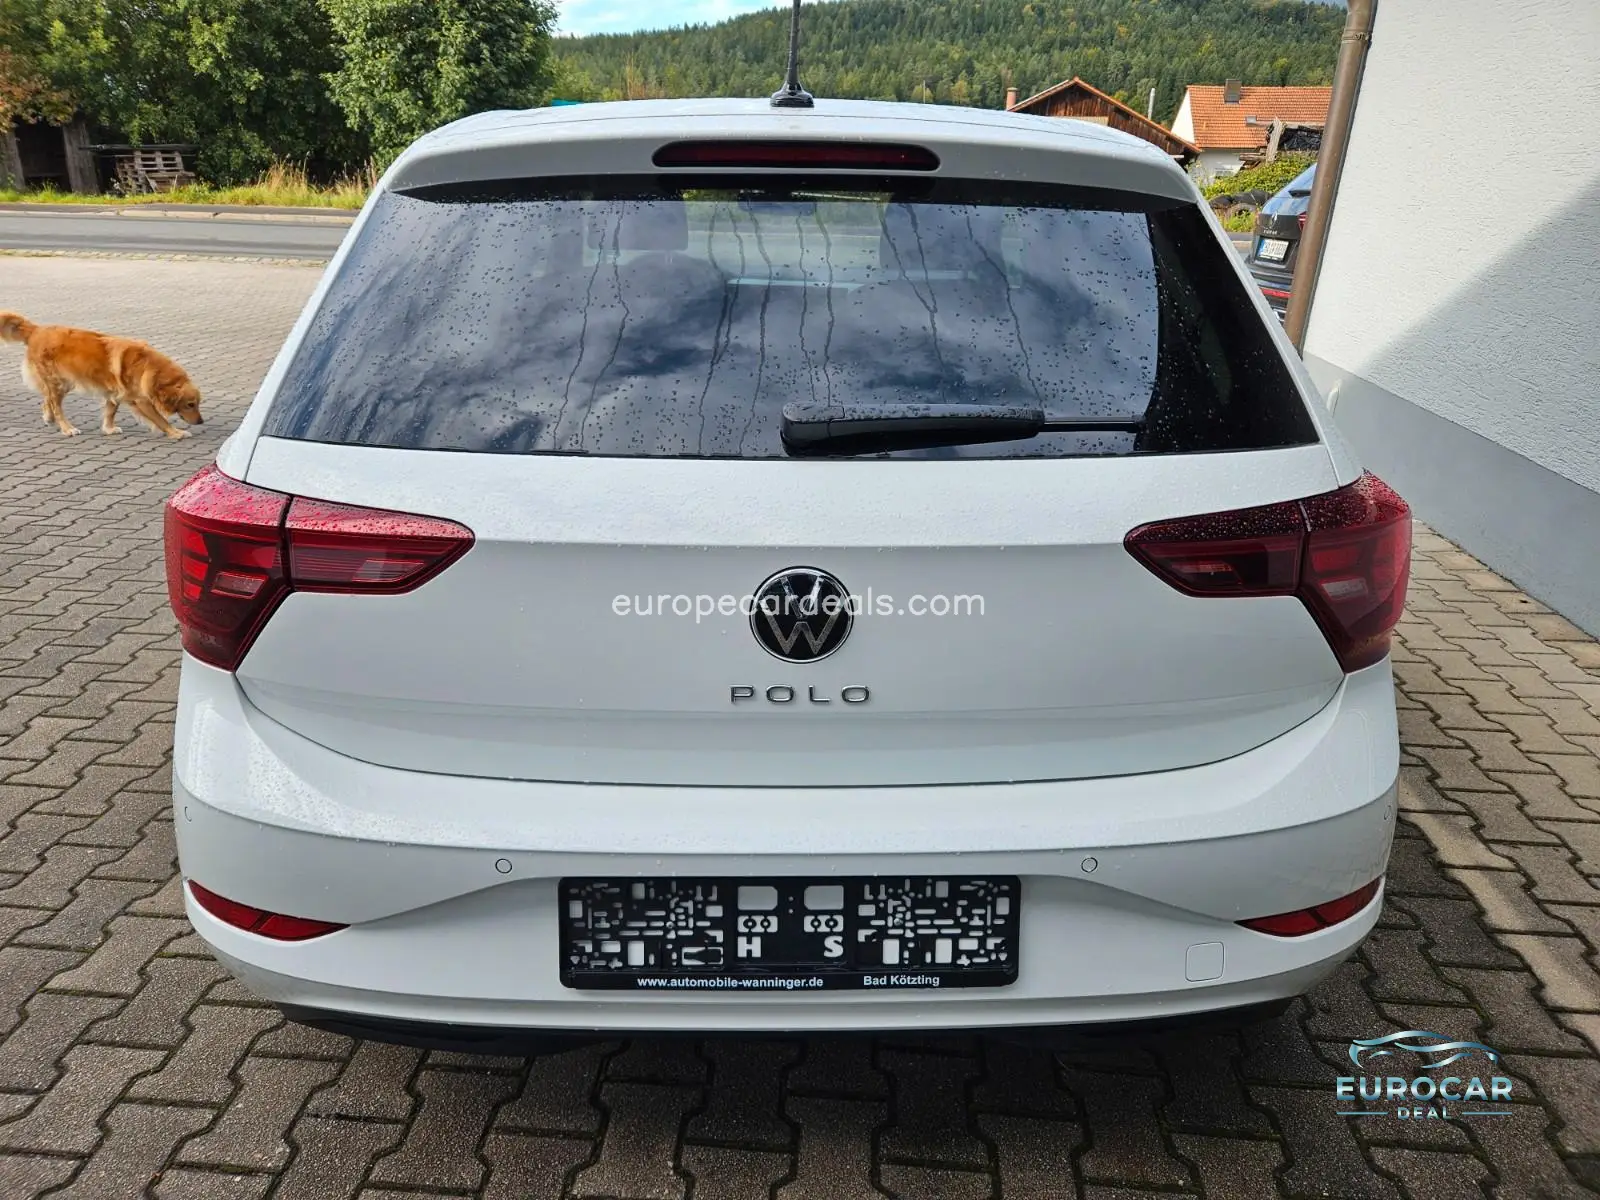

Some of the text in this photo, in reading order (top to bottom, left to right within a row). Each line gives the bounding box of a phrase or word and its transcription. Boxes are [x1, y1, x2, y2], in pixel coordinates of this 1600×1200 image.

[729, 684, 871, 703] POLO
[637, 976, 824, 989] www.automobile-wanninger.de
[863, 974, 940, 987] Bad Kötzting
